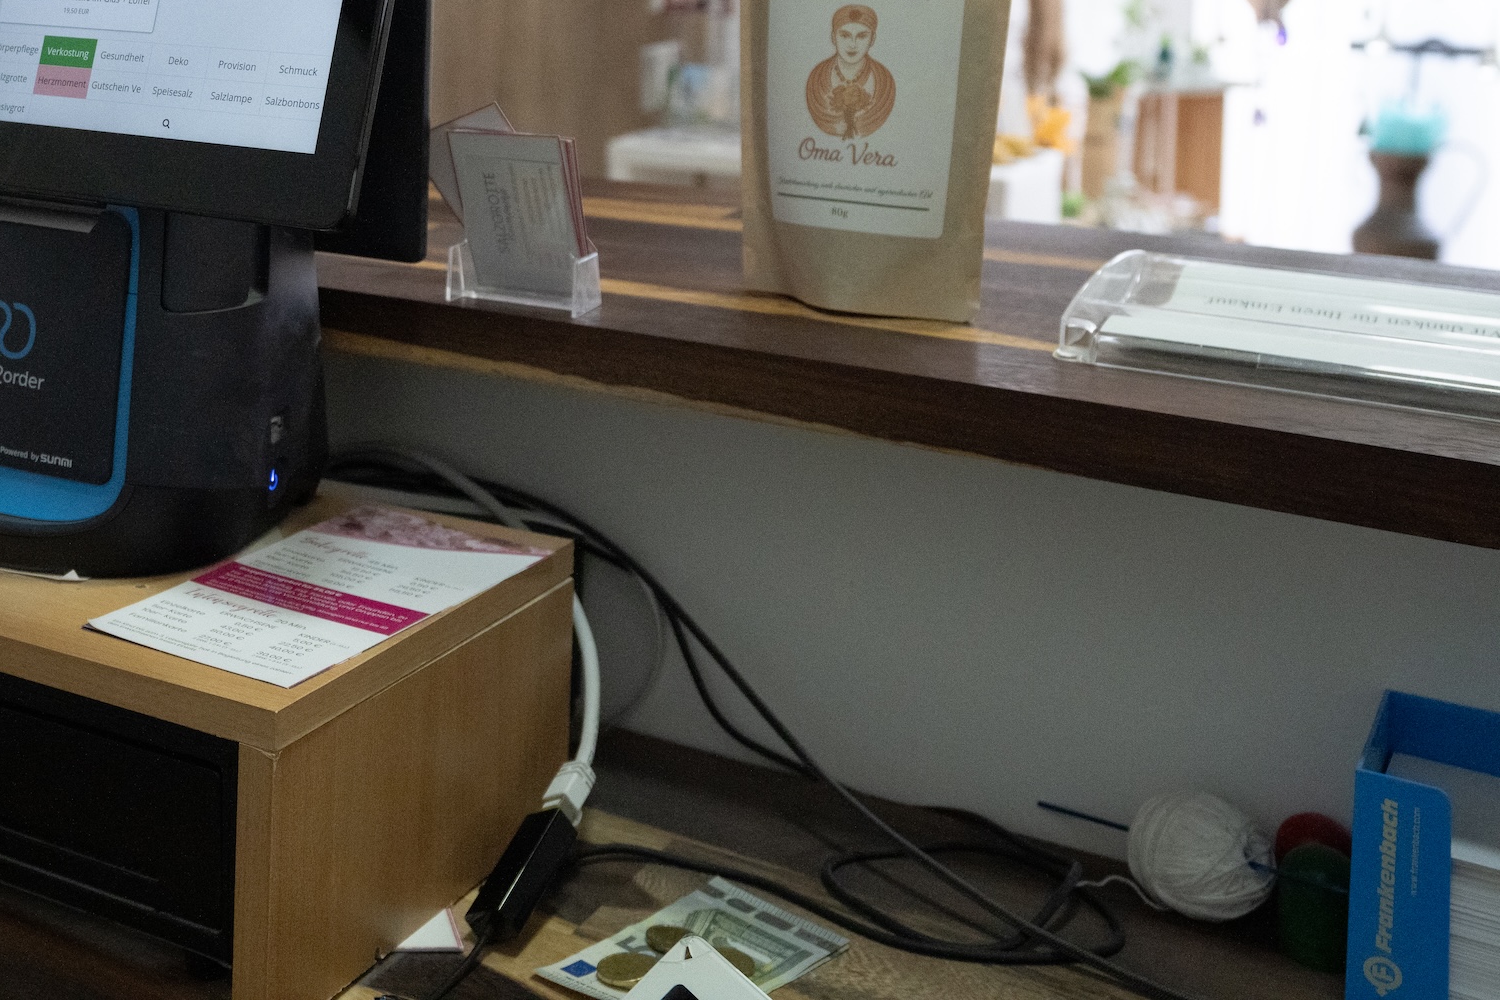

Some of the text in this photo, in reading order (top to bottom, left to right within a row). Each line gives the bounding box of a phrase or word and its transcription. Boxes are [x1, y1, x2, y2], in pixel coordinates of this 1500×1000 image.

[47, 47, 89, 60] Verkostung
[101, 51, 144, 63] Gesundheit
[168, 56, 188, 66] Deko
[218, 60, 256, 71] Provision
[279, 65, 318, 76] Schmuck
[38, 76, 86, 88] Herzmoment
[92, 81, 141, 93] Gutschein Ve
[152, 86, 193, 99] Speisesalz
[210, 92, 252, 103] Salzlampe
[265, 96, 319, 109] Salzbonbons
[798, 137, 897, 167] Oma Vera
[1387, 317, 1463, 333] danken
[0, 446, 28, 459] Powered
[31, 452, 40, 462] by
[219, 610, 277, 630] ERWACHSENE
[300, 633, 329, 643] KINDER
[1376, 798, 1398, 953] Frankenbach
